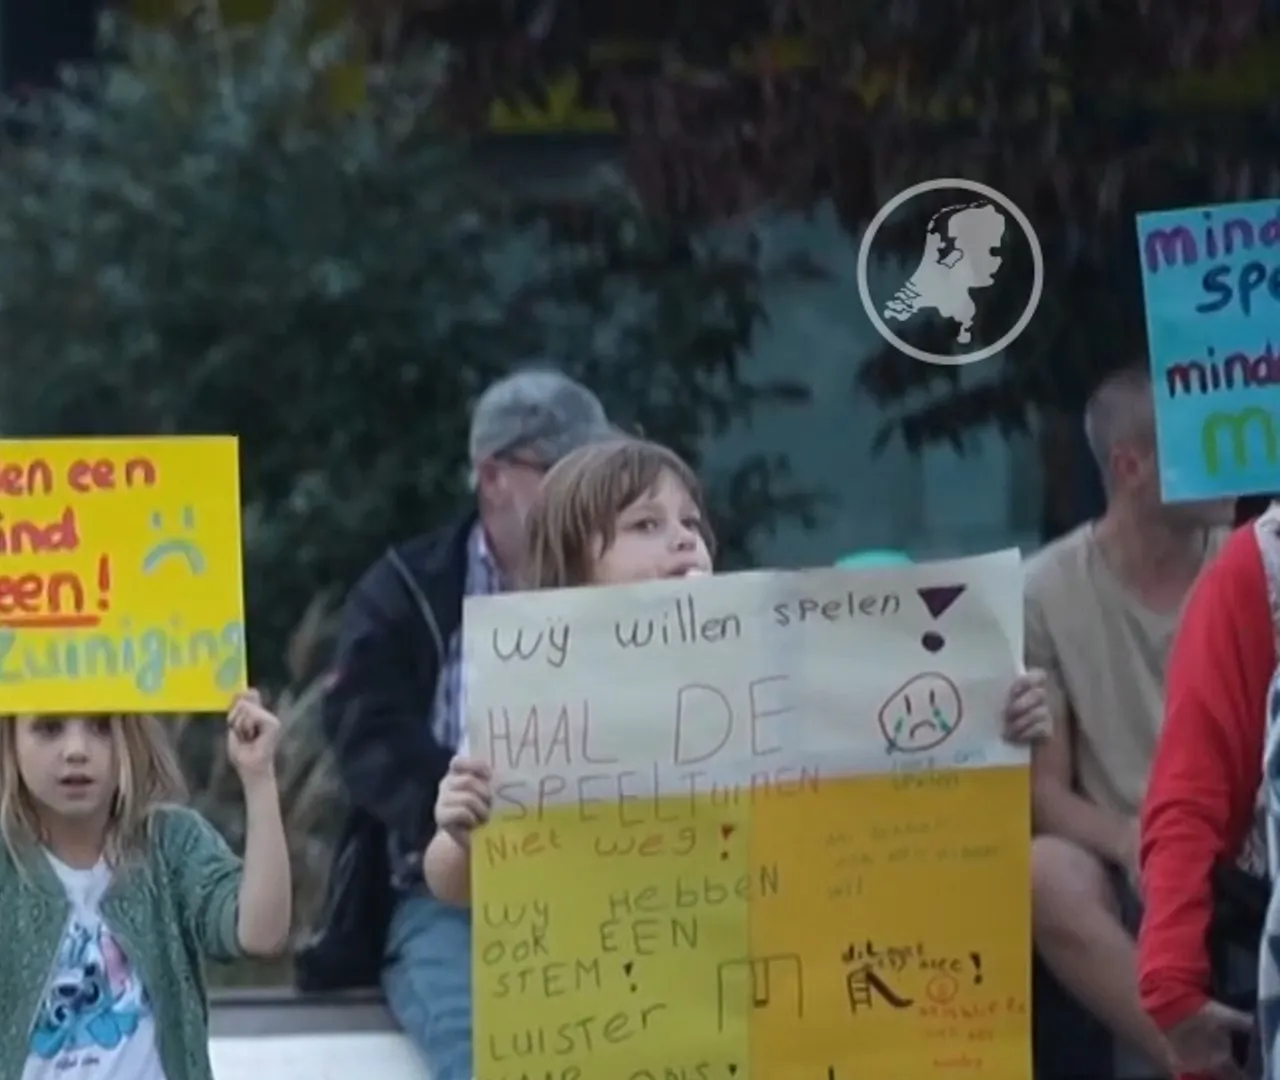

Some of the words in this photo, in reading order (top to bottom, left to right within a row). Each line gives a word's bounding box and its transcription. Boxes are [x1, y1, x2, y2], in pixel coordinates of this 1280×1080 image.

[67, 458, 157, 493] een
[615, 593, 741, 648] willen
[487, 699, 620, 768] HAAL
[674, 674, 793, 767] DE
[600, 915, 698, 956] EEN
